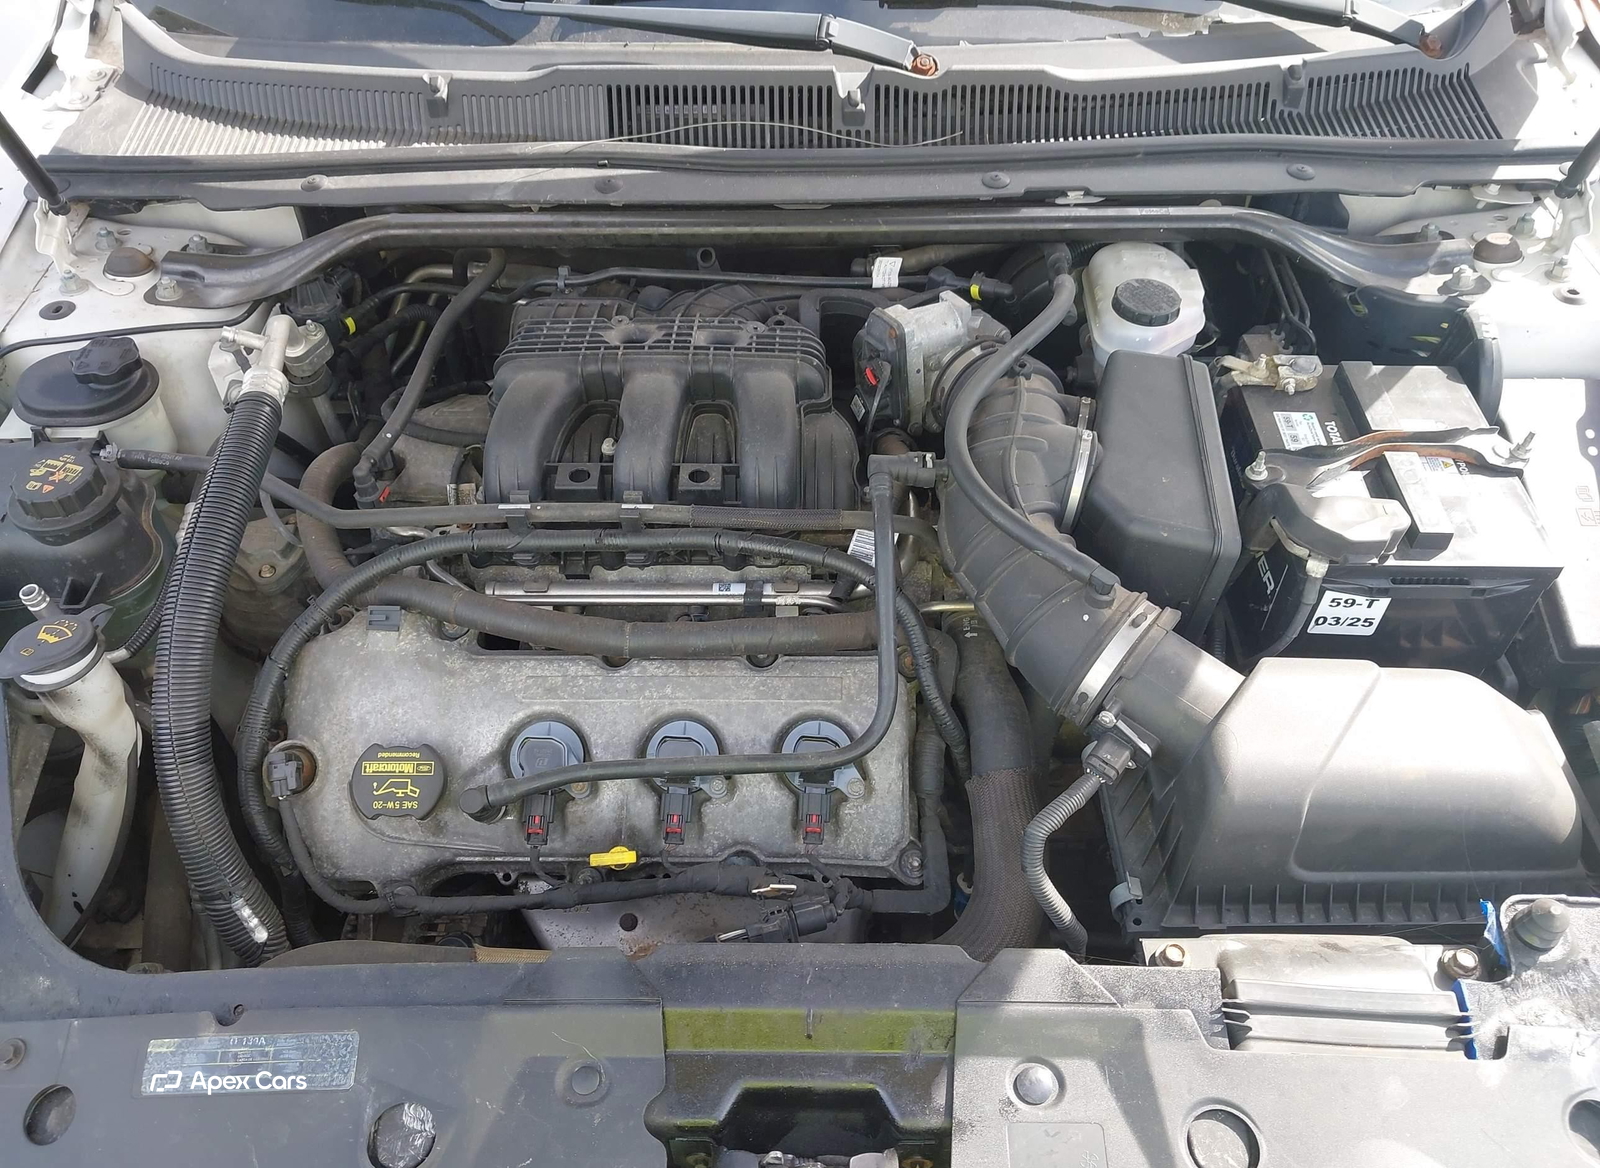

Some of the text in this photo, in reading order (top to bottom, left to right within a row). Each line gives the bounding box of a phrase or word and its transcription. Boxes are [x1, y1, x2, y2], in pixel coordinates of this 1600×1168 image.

[1328, 598, 1380, 609] 59-T
[1314, 616, 1376, 628] 03/25
[365, 764, 414, 773] Motorcraft
[373, 801, 418, 809] SAE 5W-20
